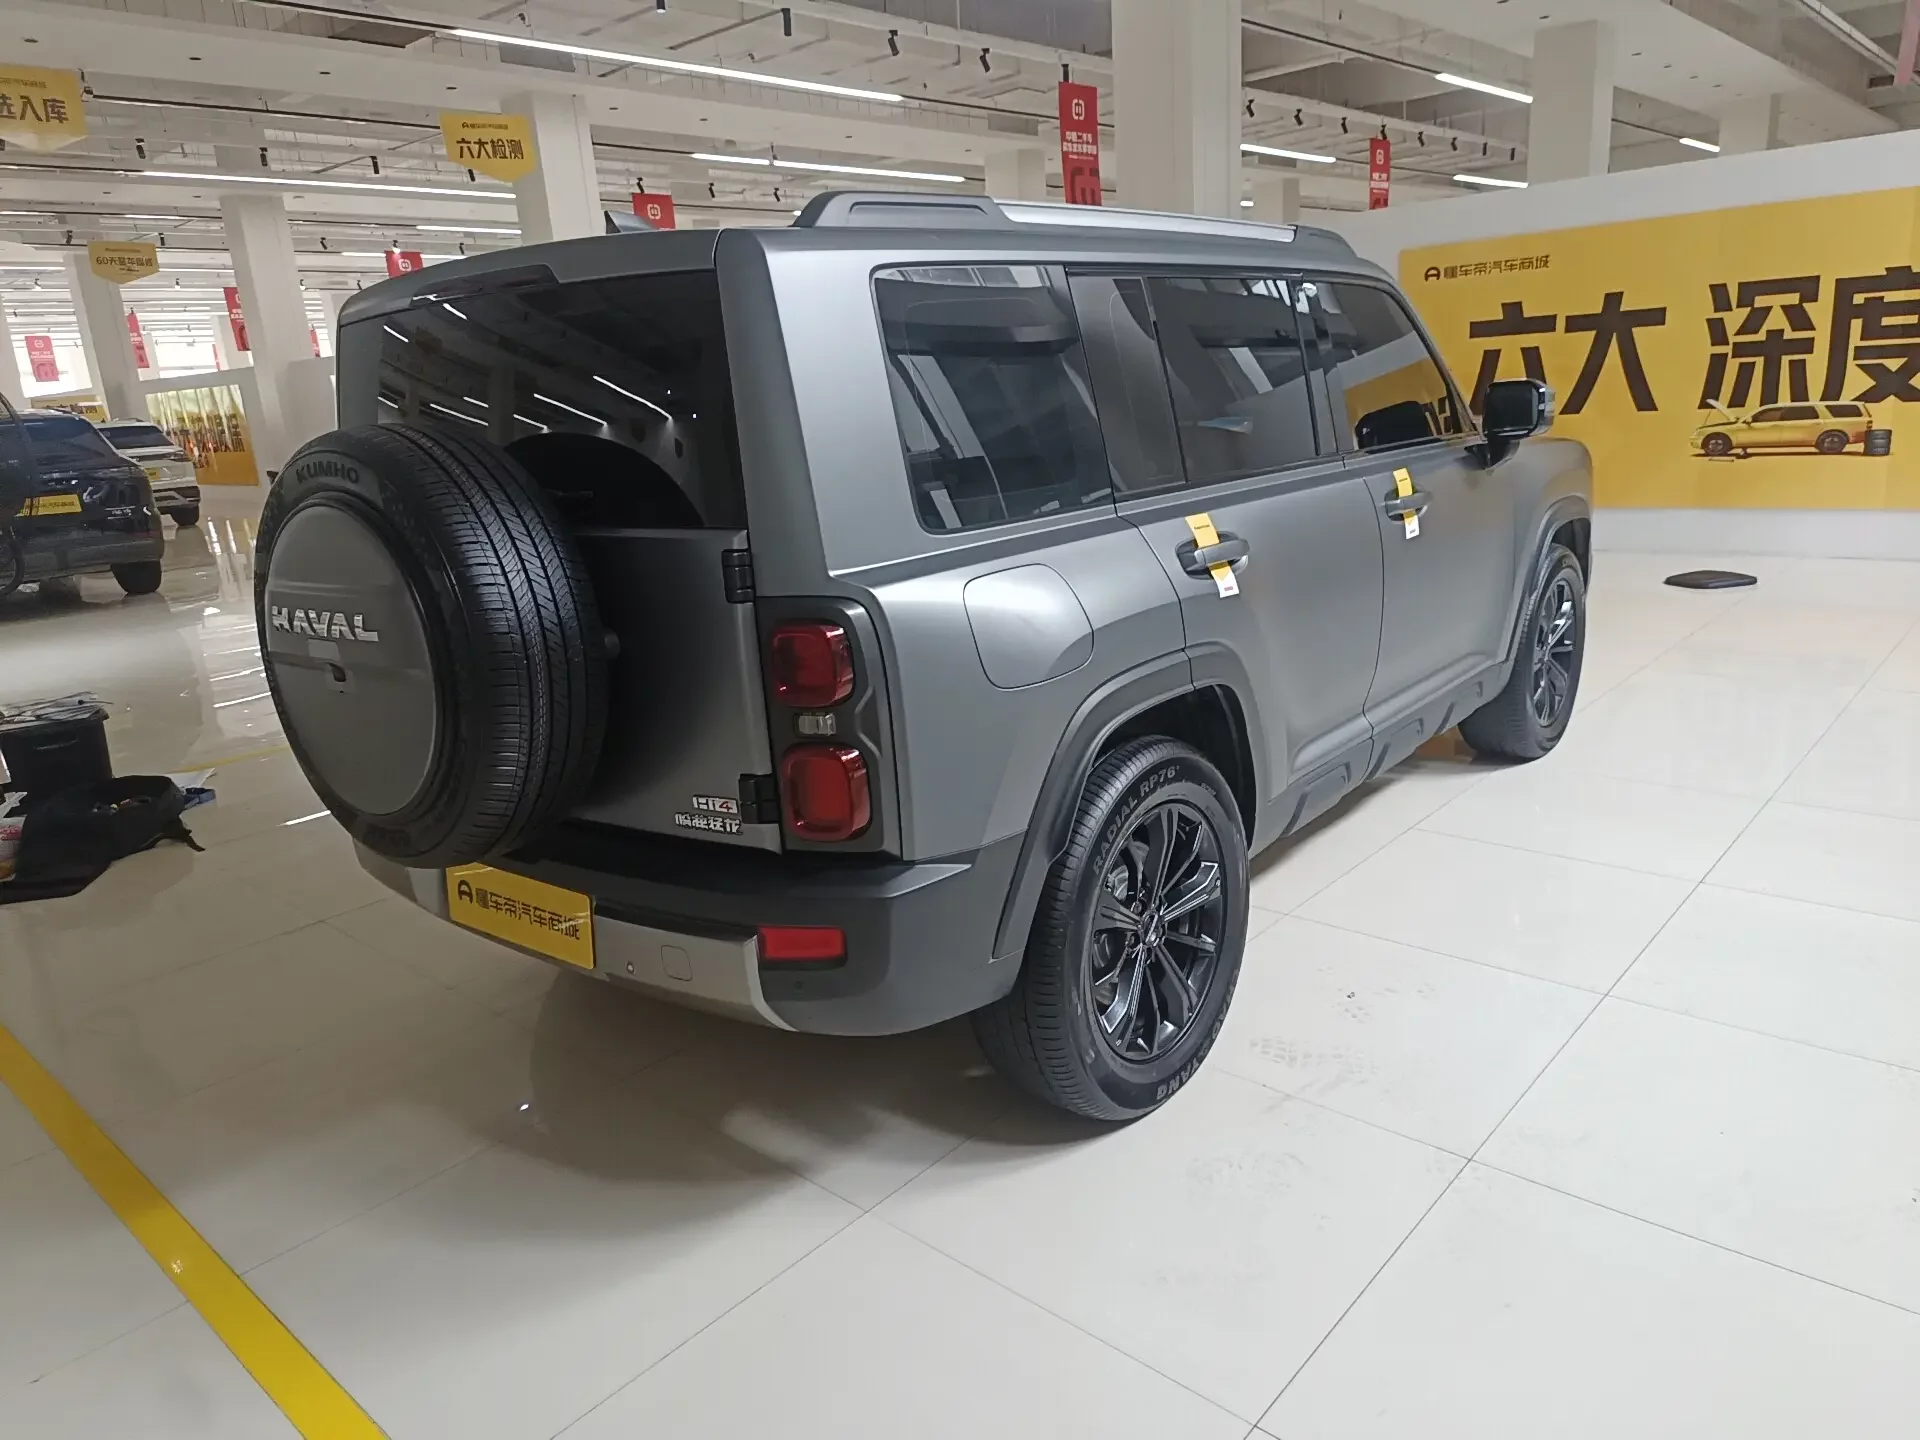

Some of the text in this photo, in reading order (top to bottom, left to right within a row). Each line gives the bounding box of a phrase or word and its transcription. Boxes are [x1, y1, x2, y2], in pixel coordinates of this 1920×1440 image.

[456, 138, 524, 159] 六大检测
[1469, 265, 1920, 415] 六大 深度
[296, 461, 359, 484] KUMHO
[272, 606, 379, 642] HAVAL
[1093, 796, 1138, 875] RADIAL
